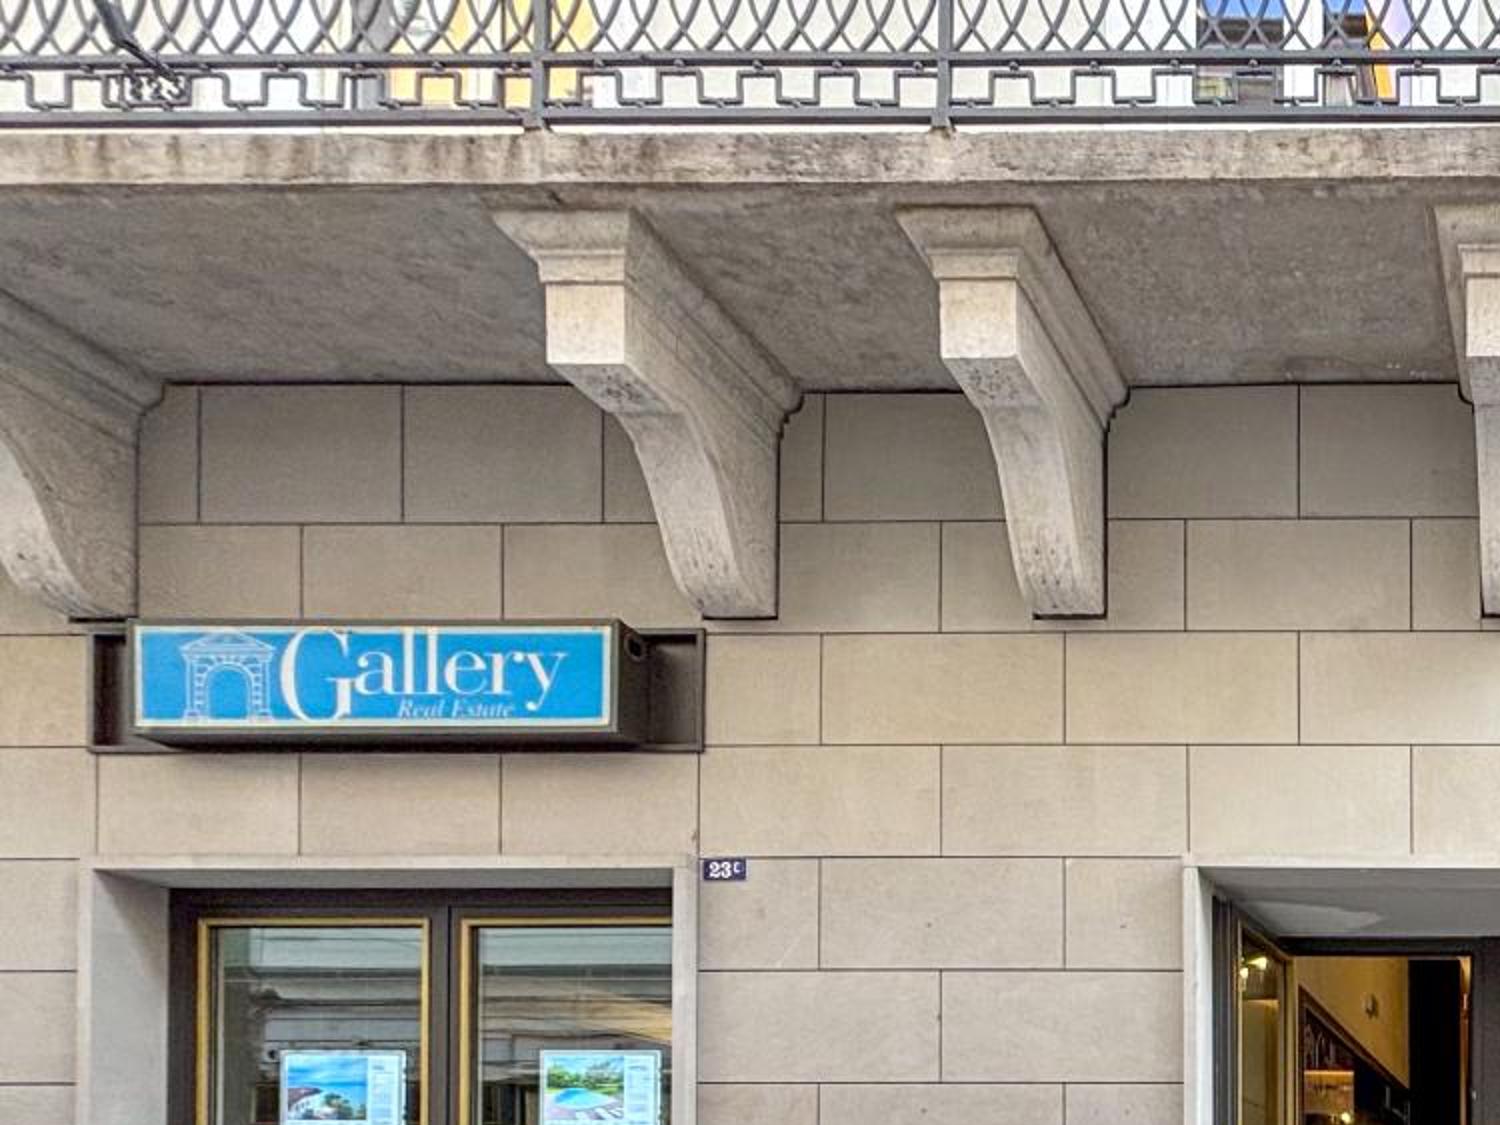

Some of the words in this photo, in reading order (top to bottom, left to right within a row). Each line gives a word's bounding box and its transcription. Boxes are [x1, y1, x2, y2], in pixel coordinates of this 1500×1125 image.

[280, 627, 568, 721] Gallery
[398, 699, 445, 719] Real
[451, 699, 514, 719] Estate
